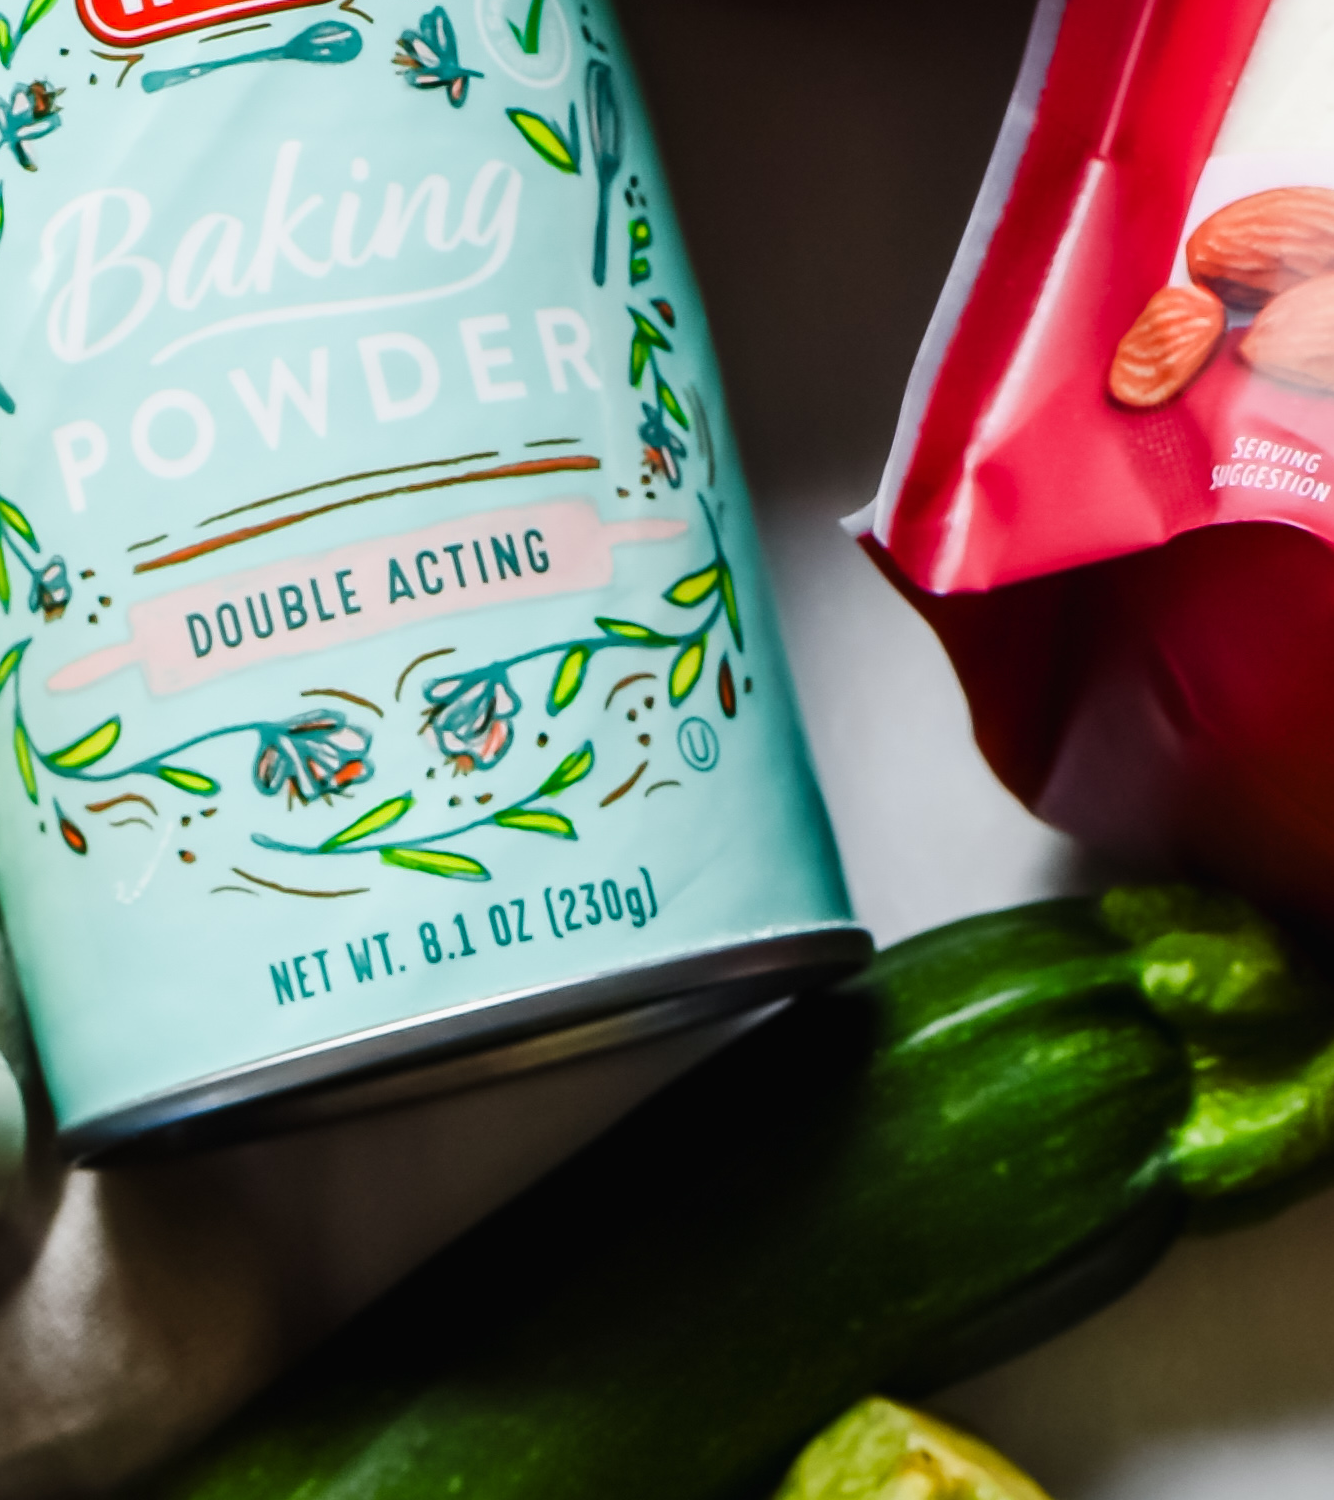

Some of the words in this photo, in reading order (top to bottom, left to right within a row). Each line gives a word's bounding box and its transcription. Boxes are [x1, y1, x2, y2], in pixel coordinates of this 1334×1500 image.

[39, 139, 525, 365] Baking
[51, 305, 605, 515] POWDER
[1230, 435, 1325, 475] SERVING
[1210, 463, 1334, 504] SUGGESTION
[185, 567, 365, 660] DOUBLE
[385, 527, 554, 606] ACTING
[268, 947, 333, 1006] NET
[346, 930, 408, 985] WT.
[419, 912, 478, 966] 8.1
[489, 897, 535, 949] OZ
[544, 865, 661, 940] (230g)
